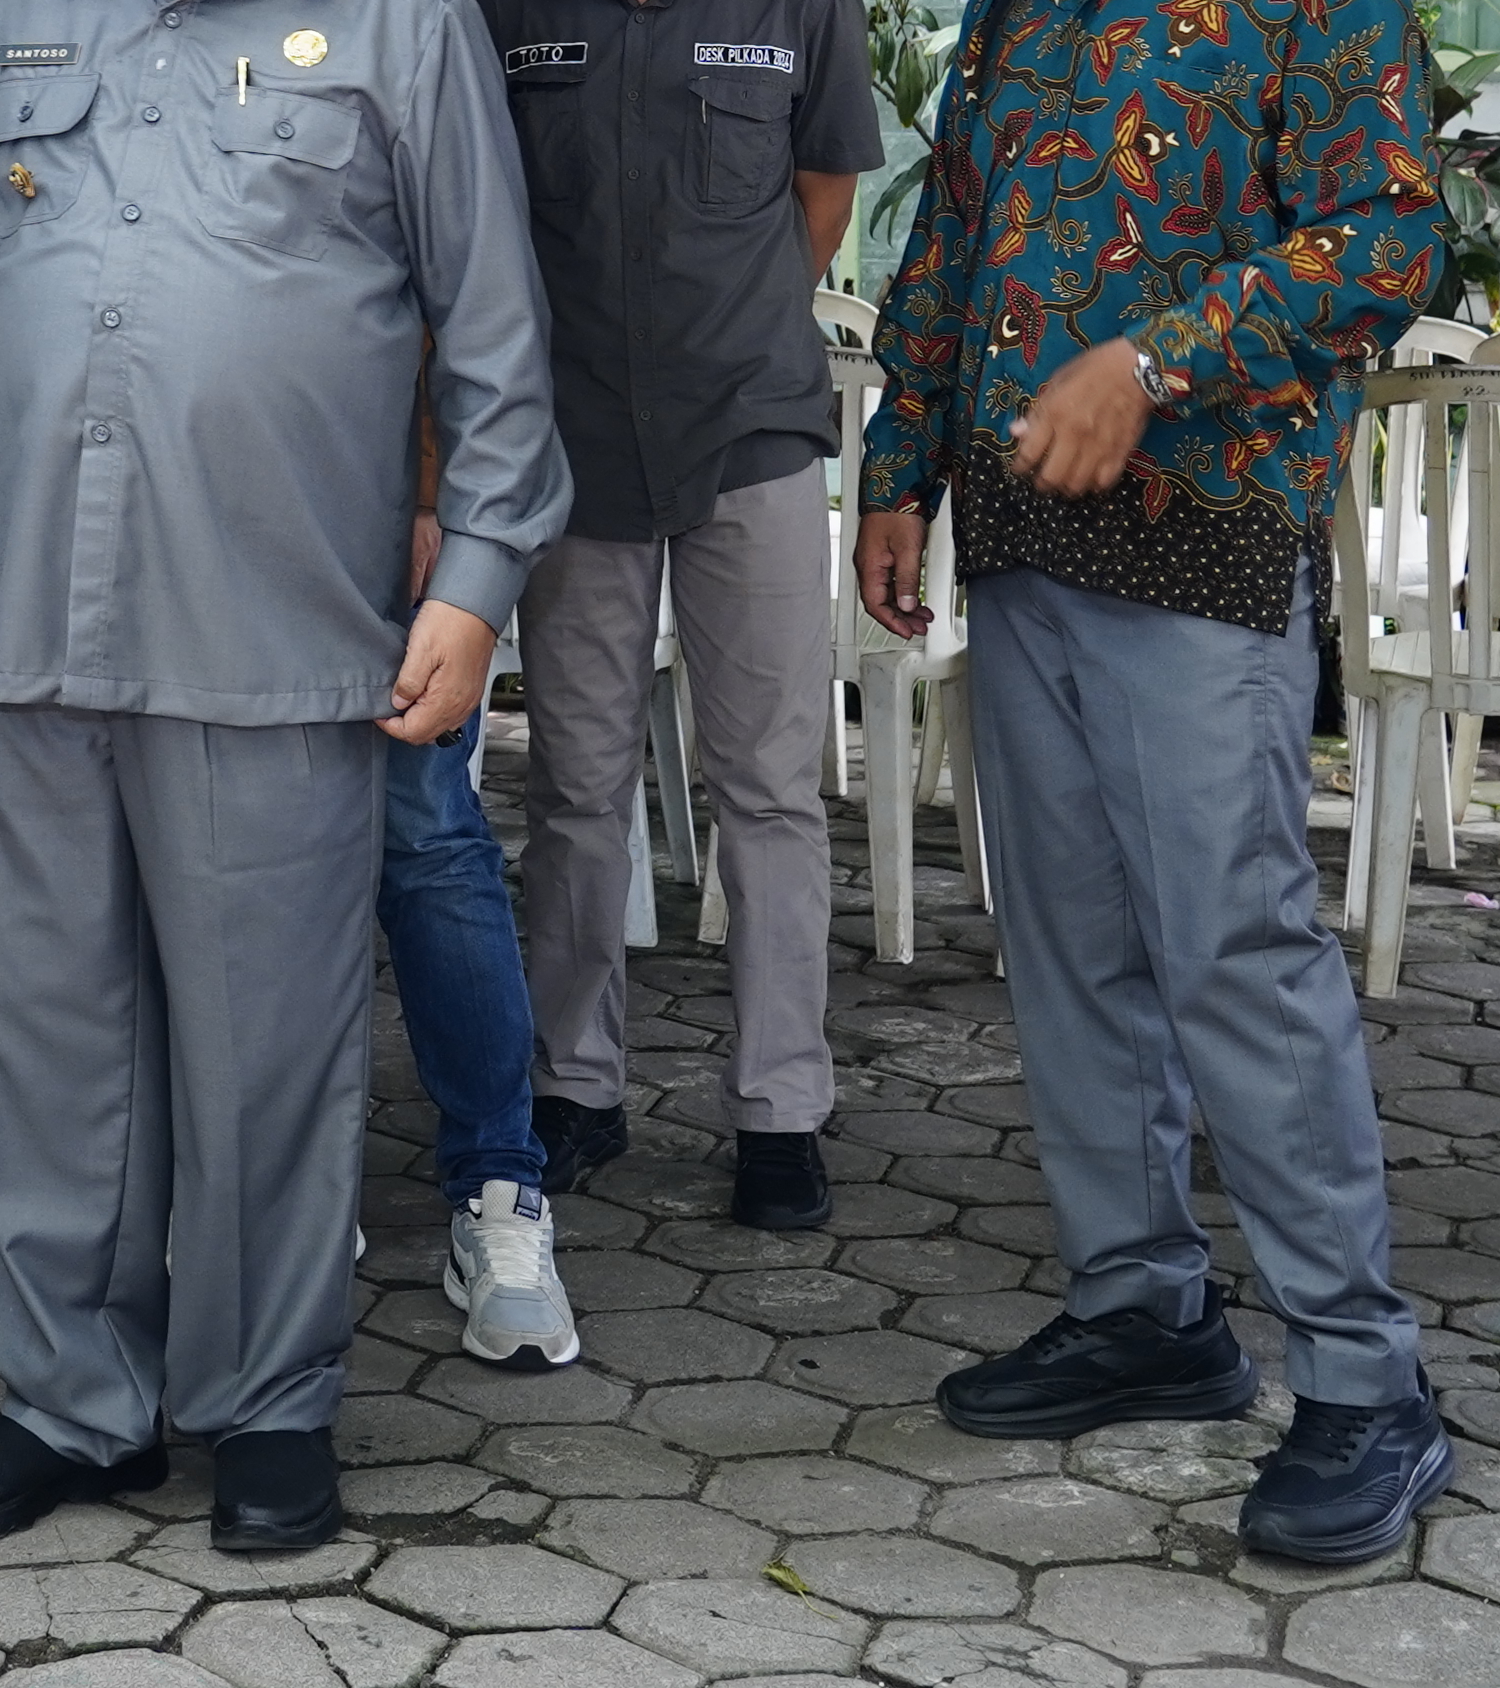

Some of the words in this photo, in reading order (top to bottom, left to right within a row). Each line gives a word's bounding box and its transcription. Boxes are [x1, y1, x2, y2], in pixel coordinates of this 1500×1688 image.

[5, 48, 68, 59] SANTOSO
[519, 46, 563, 64] TOTO
[700, 47, 725, 62] DESK
[728, 48, 771, 64] PILKADA
[773, 50, 789, 69] 2024
